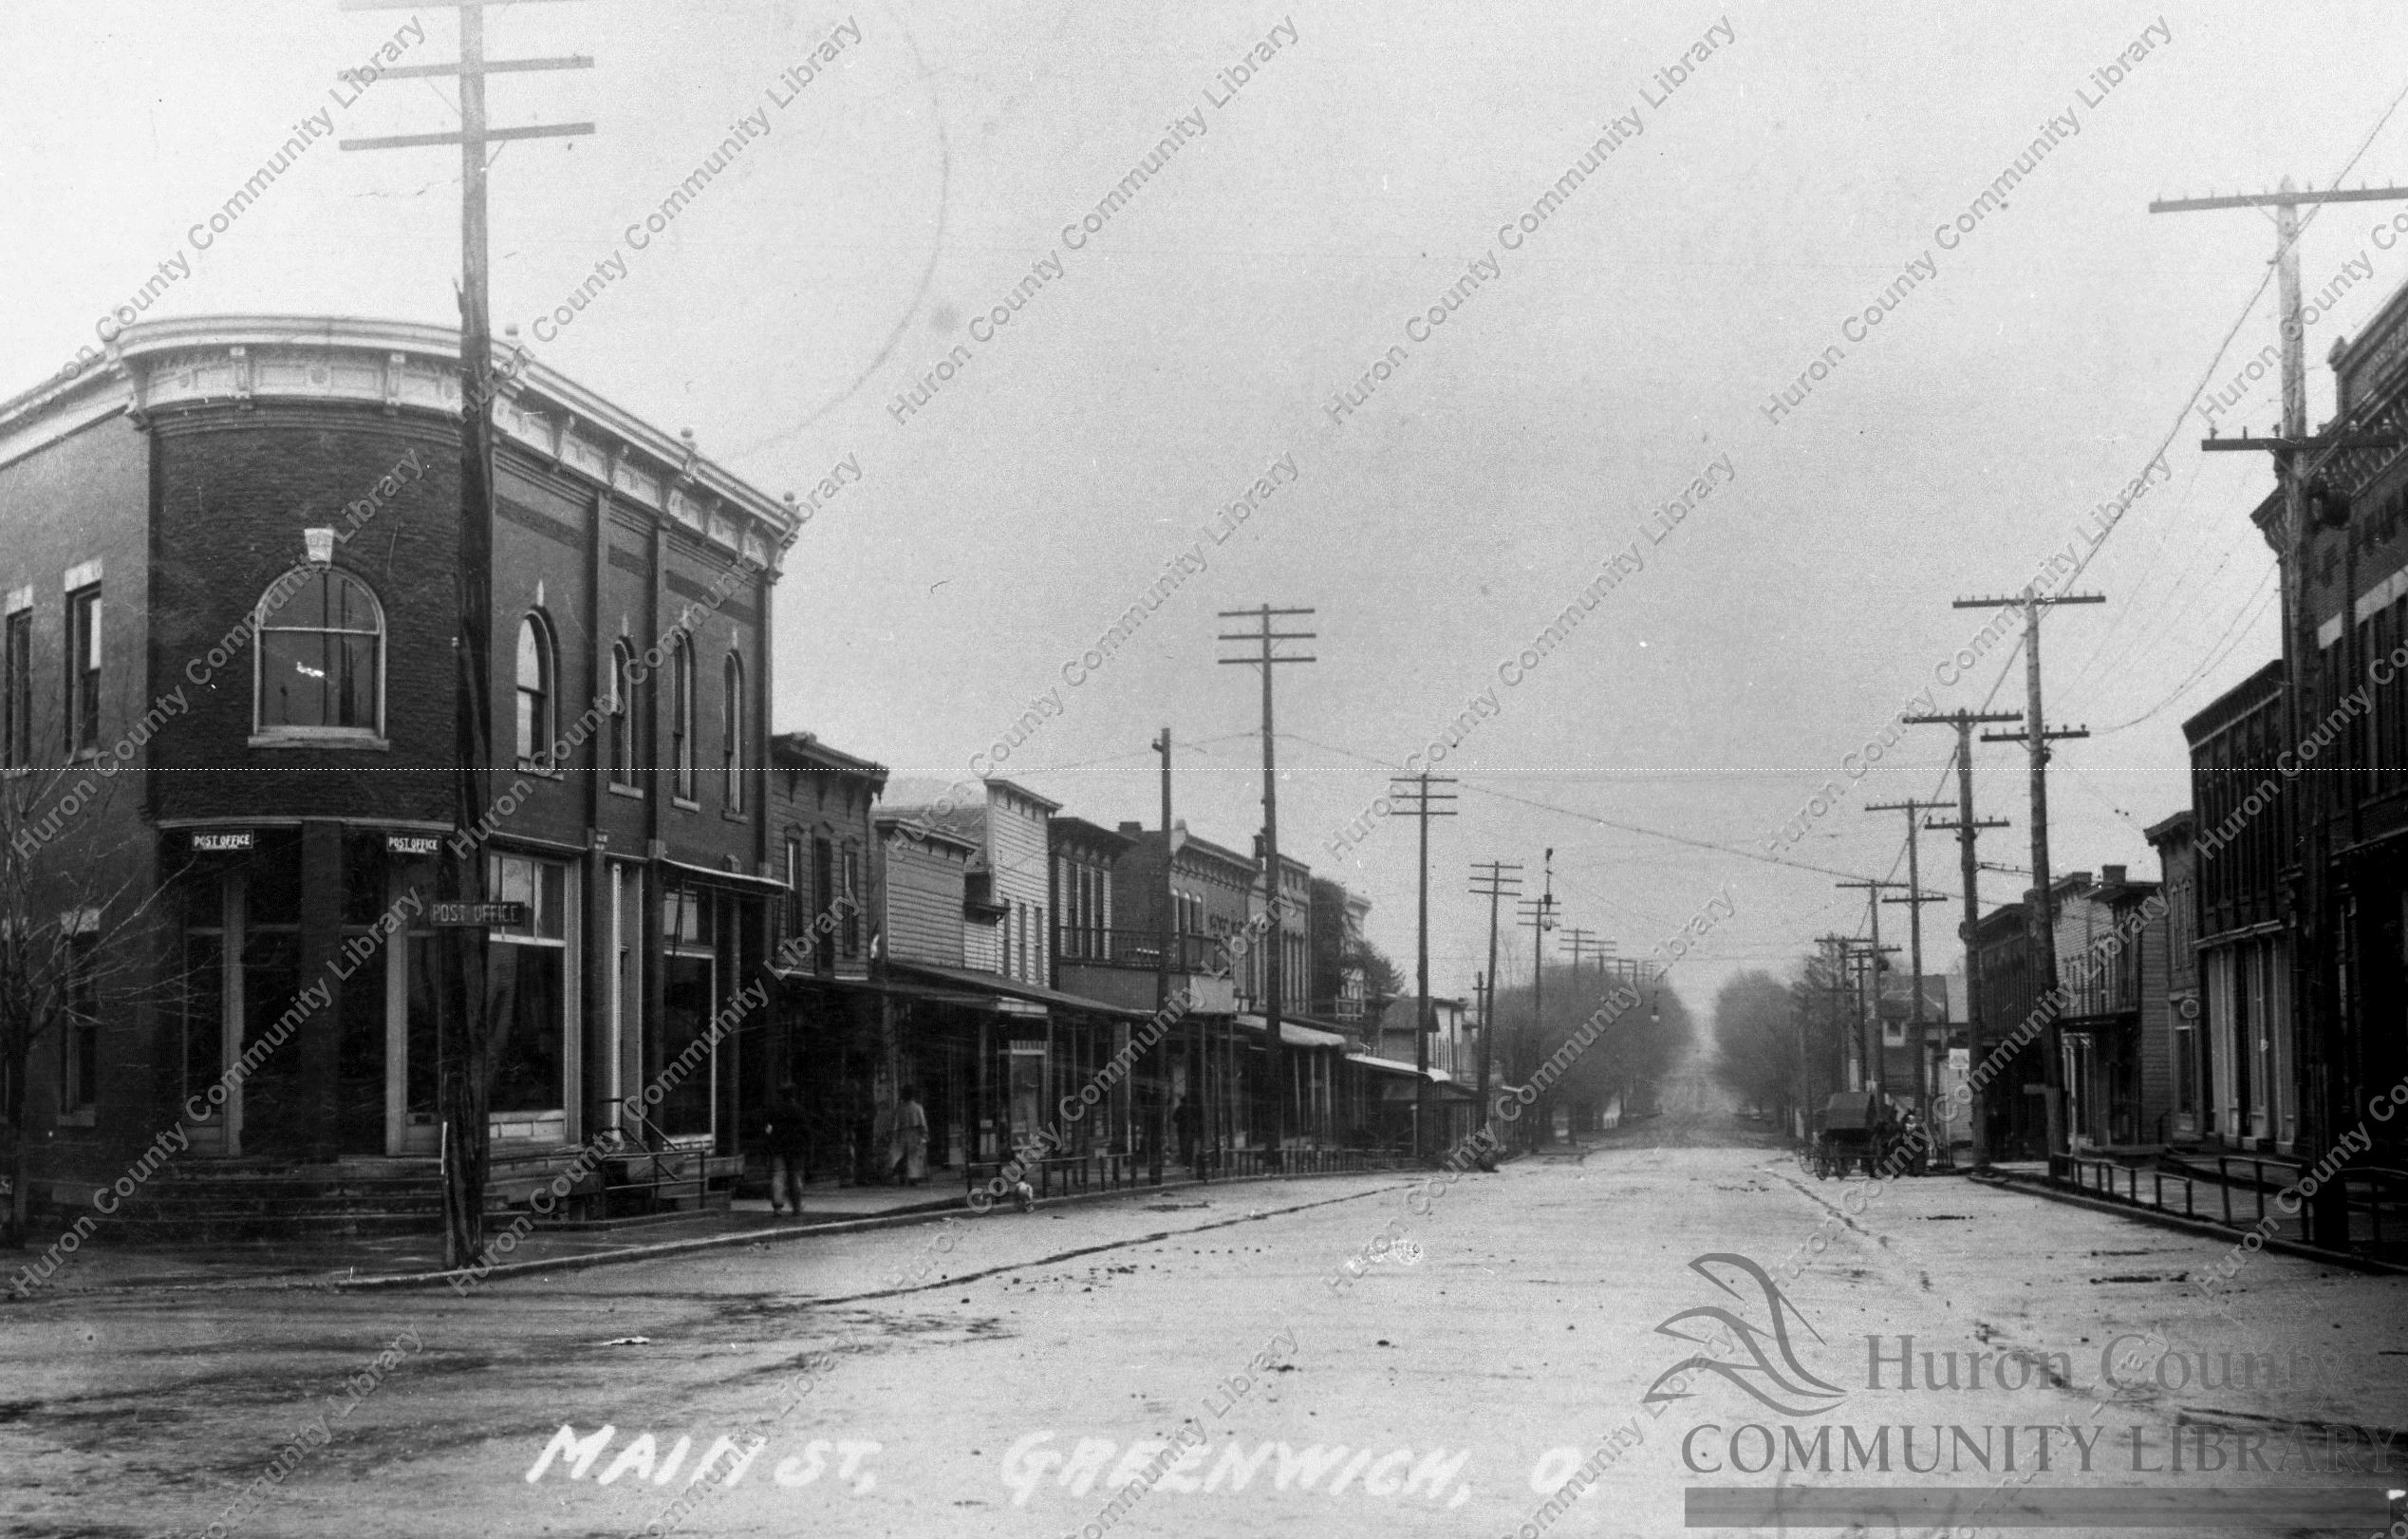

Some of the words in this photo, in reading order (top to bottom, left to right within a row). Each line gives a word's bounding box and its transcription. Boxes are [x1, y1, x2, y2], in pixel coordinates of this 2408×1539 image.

[194, 835, 218, 847] POST
[220, 834, 251, 846] OFFICE
[388, 836, 409, 848] POST
[411, 838, 438, 851] OFFICE
[433, 903, 466, 922] POST
[475, 904, 519, 922] OFFICE
